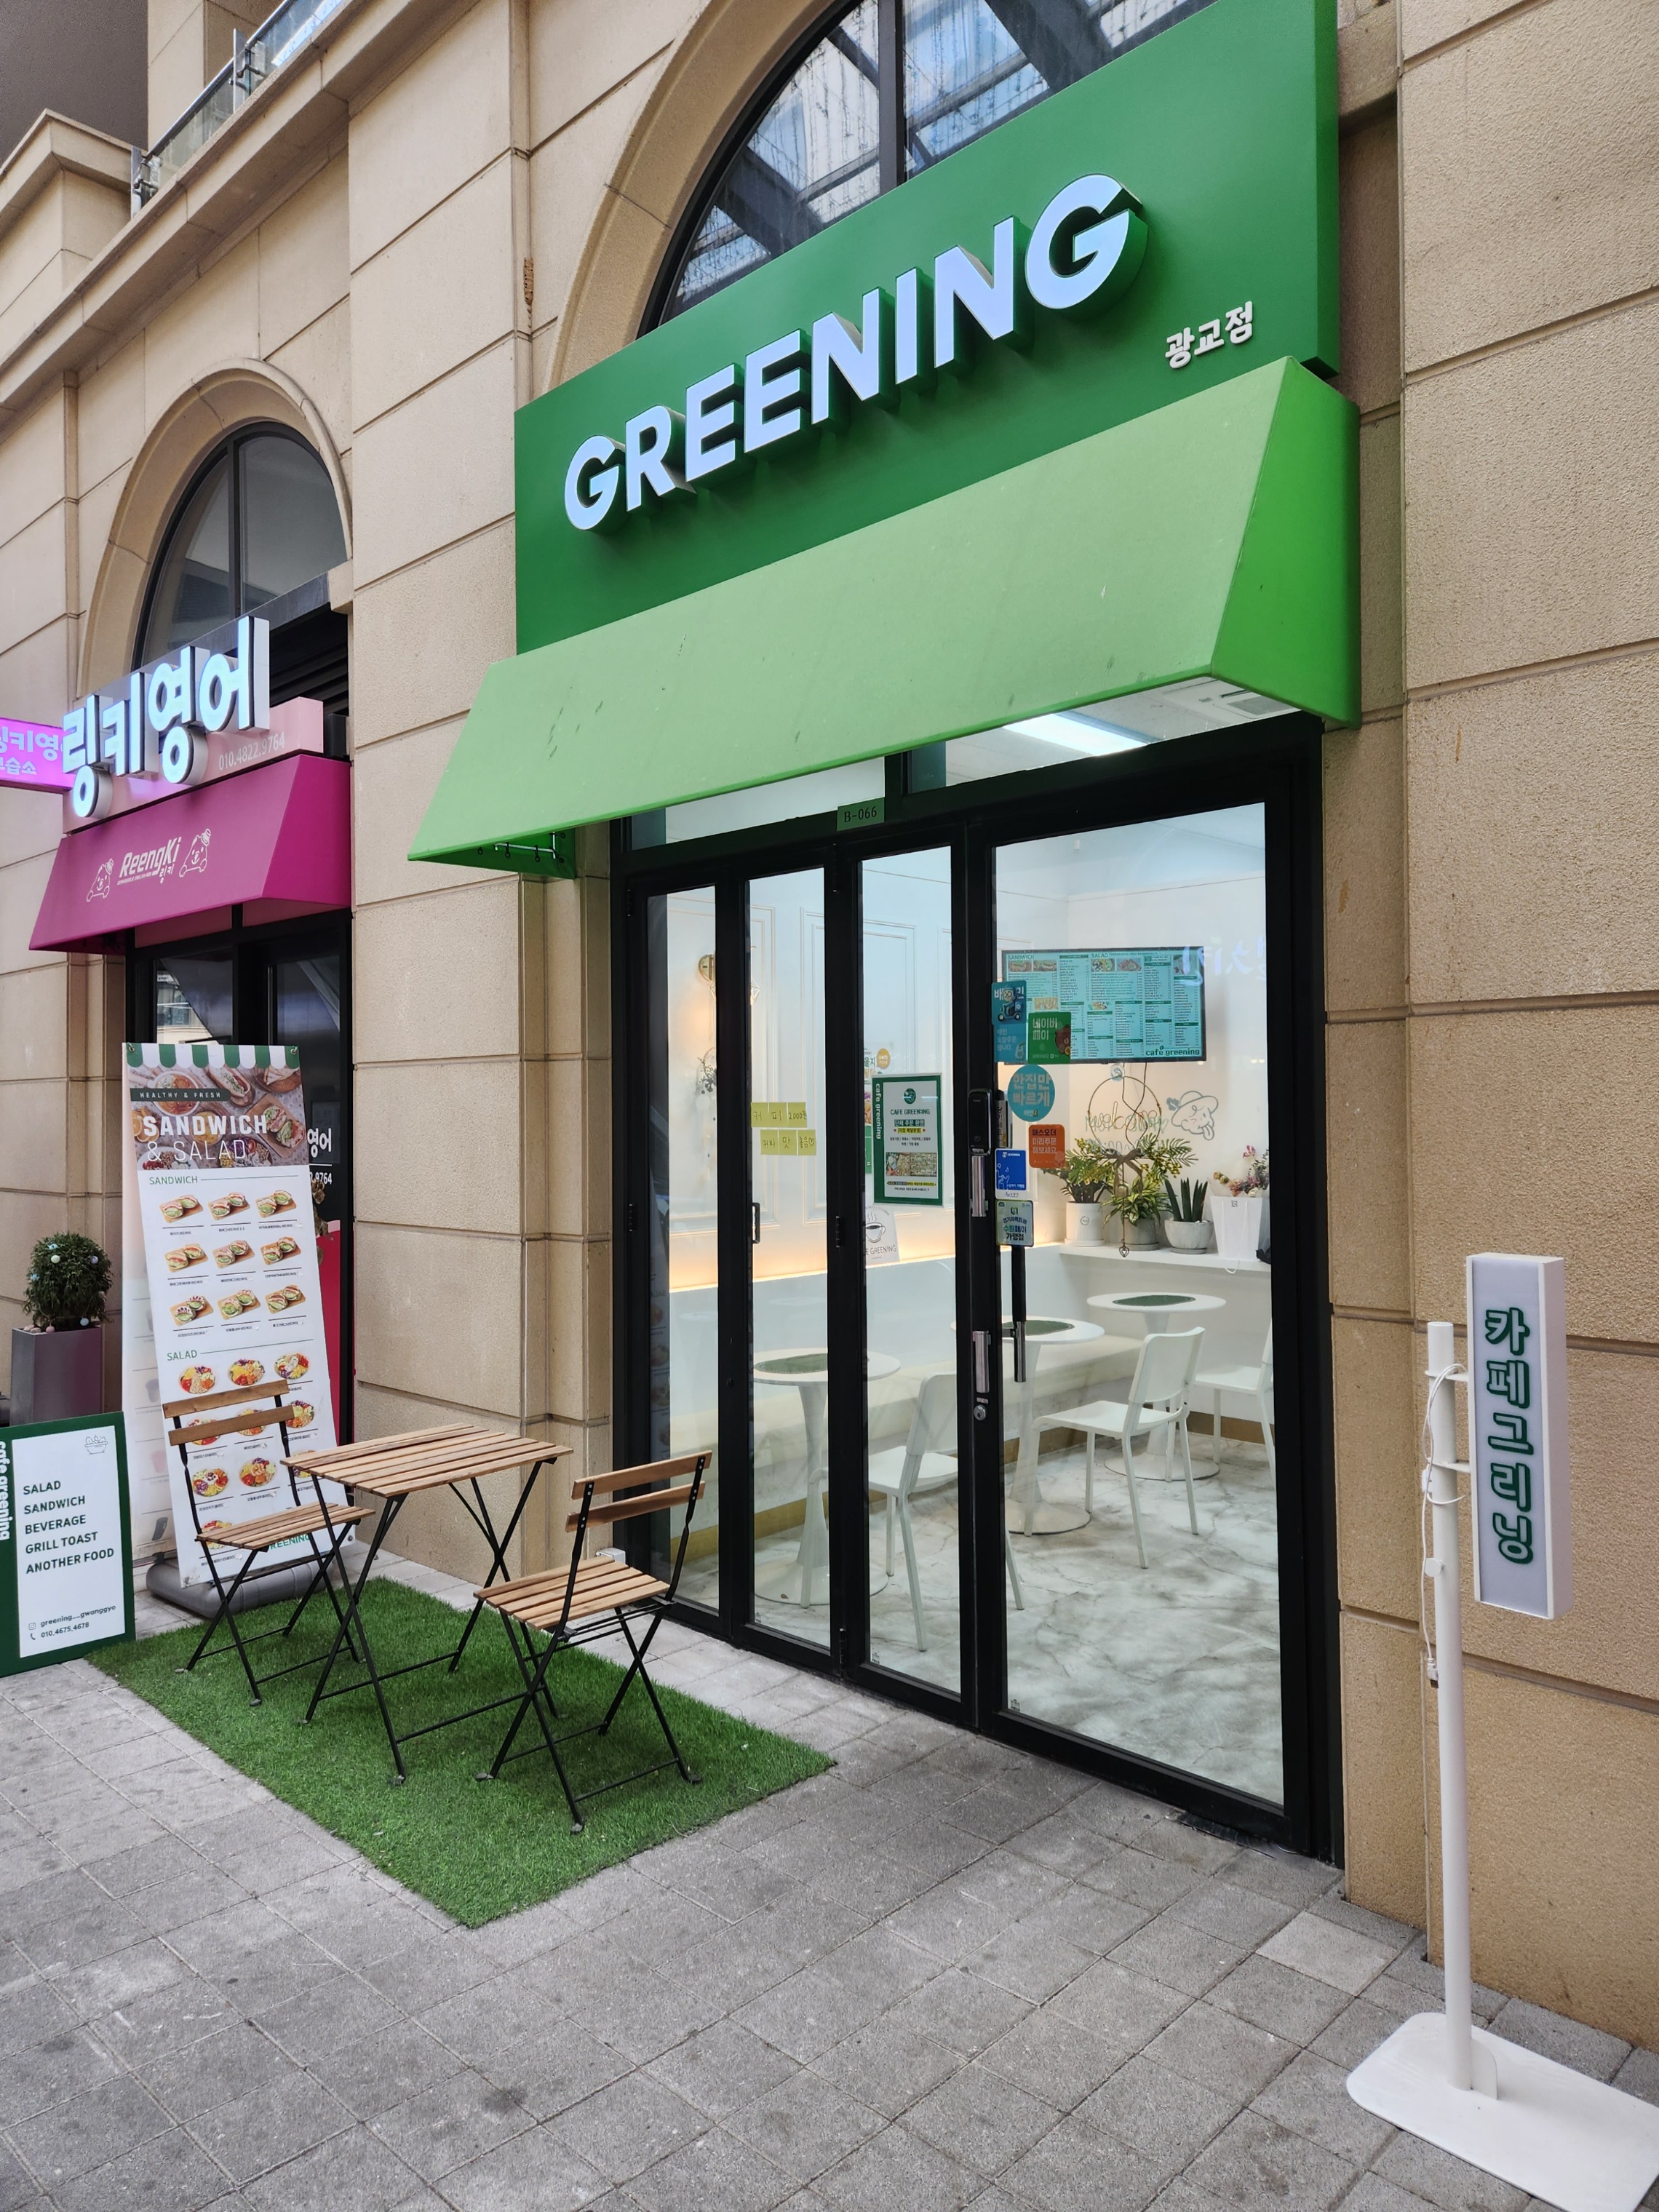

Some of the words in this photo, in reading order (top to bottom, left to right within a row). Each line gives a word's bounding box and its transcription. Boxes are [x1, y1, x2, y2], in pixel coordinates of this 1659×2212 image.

[1165, 301, 1253, 368] 광교점
[564, 173, 1138, 531] GREENING
[62, 616, 262, 818] 링키영어
[0, 726, 63, 761] 키영
[219, 731, 285, 770] 010.4822.9764
[844, 805, 877, 823] B-066
[119, 836, 182, 878] ReengKi
[159, 863, 175, 884] 링키
[1033, 1017, 1058, 1029] 네이버
[1033, 1030, 1049, 1041] 페이
[1165, 1048, 1200, 1057] greening
[1013, 1073, 1051, 1090] 한집만
[1013, 1091, 1050, 1107] 빠르게
[143, 1115, 268, 1137] SANDWICH
[147, 1140, 162, 1161] &
[174, 1139, 247, 1161] SALAD
[307, 1128, 332, 1158] 영어
[763, 1139, 776, 1148] 커피
[782, 1137, 791, 1149] 맛
[1032, 1137, 1057, 1145] 미리주문
[1033, 1146, 1057, 1154] 해보세요
[149, 1175, 198, 1185] SANDWICH
[1003, 1225, 1027, 1233] 수원페이
[1006, 1233, 1025, 1241] 가맹점
[870, 1245, 896, 1254] GREENING
[167, 1350, 198, 1361] SALAD
[1485, 1307, 1534, 1564] 카페그리닝
[23, 1480, 61, 1495] SALAD
[24, 1495, 86, 1515] SANDWICH
[25, 1514, 87, 1535] BEVERAGE
[25, 1539, 59, 1554] GRILL
[61, 1531, 98, 1547] TOAST
[26, 1554, 81, 1574] ANOTHER
[84, 1548, 114, 1563] FOOD
[41, 1622, 89, 1638] 010.4675.4678
